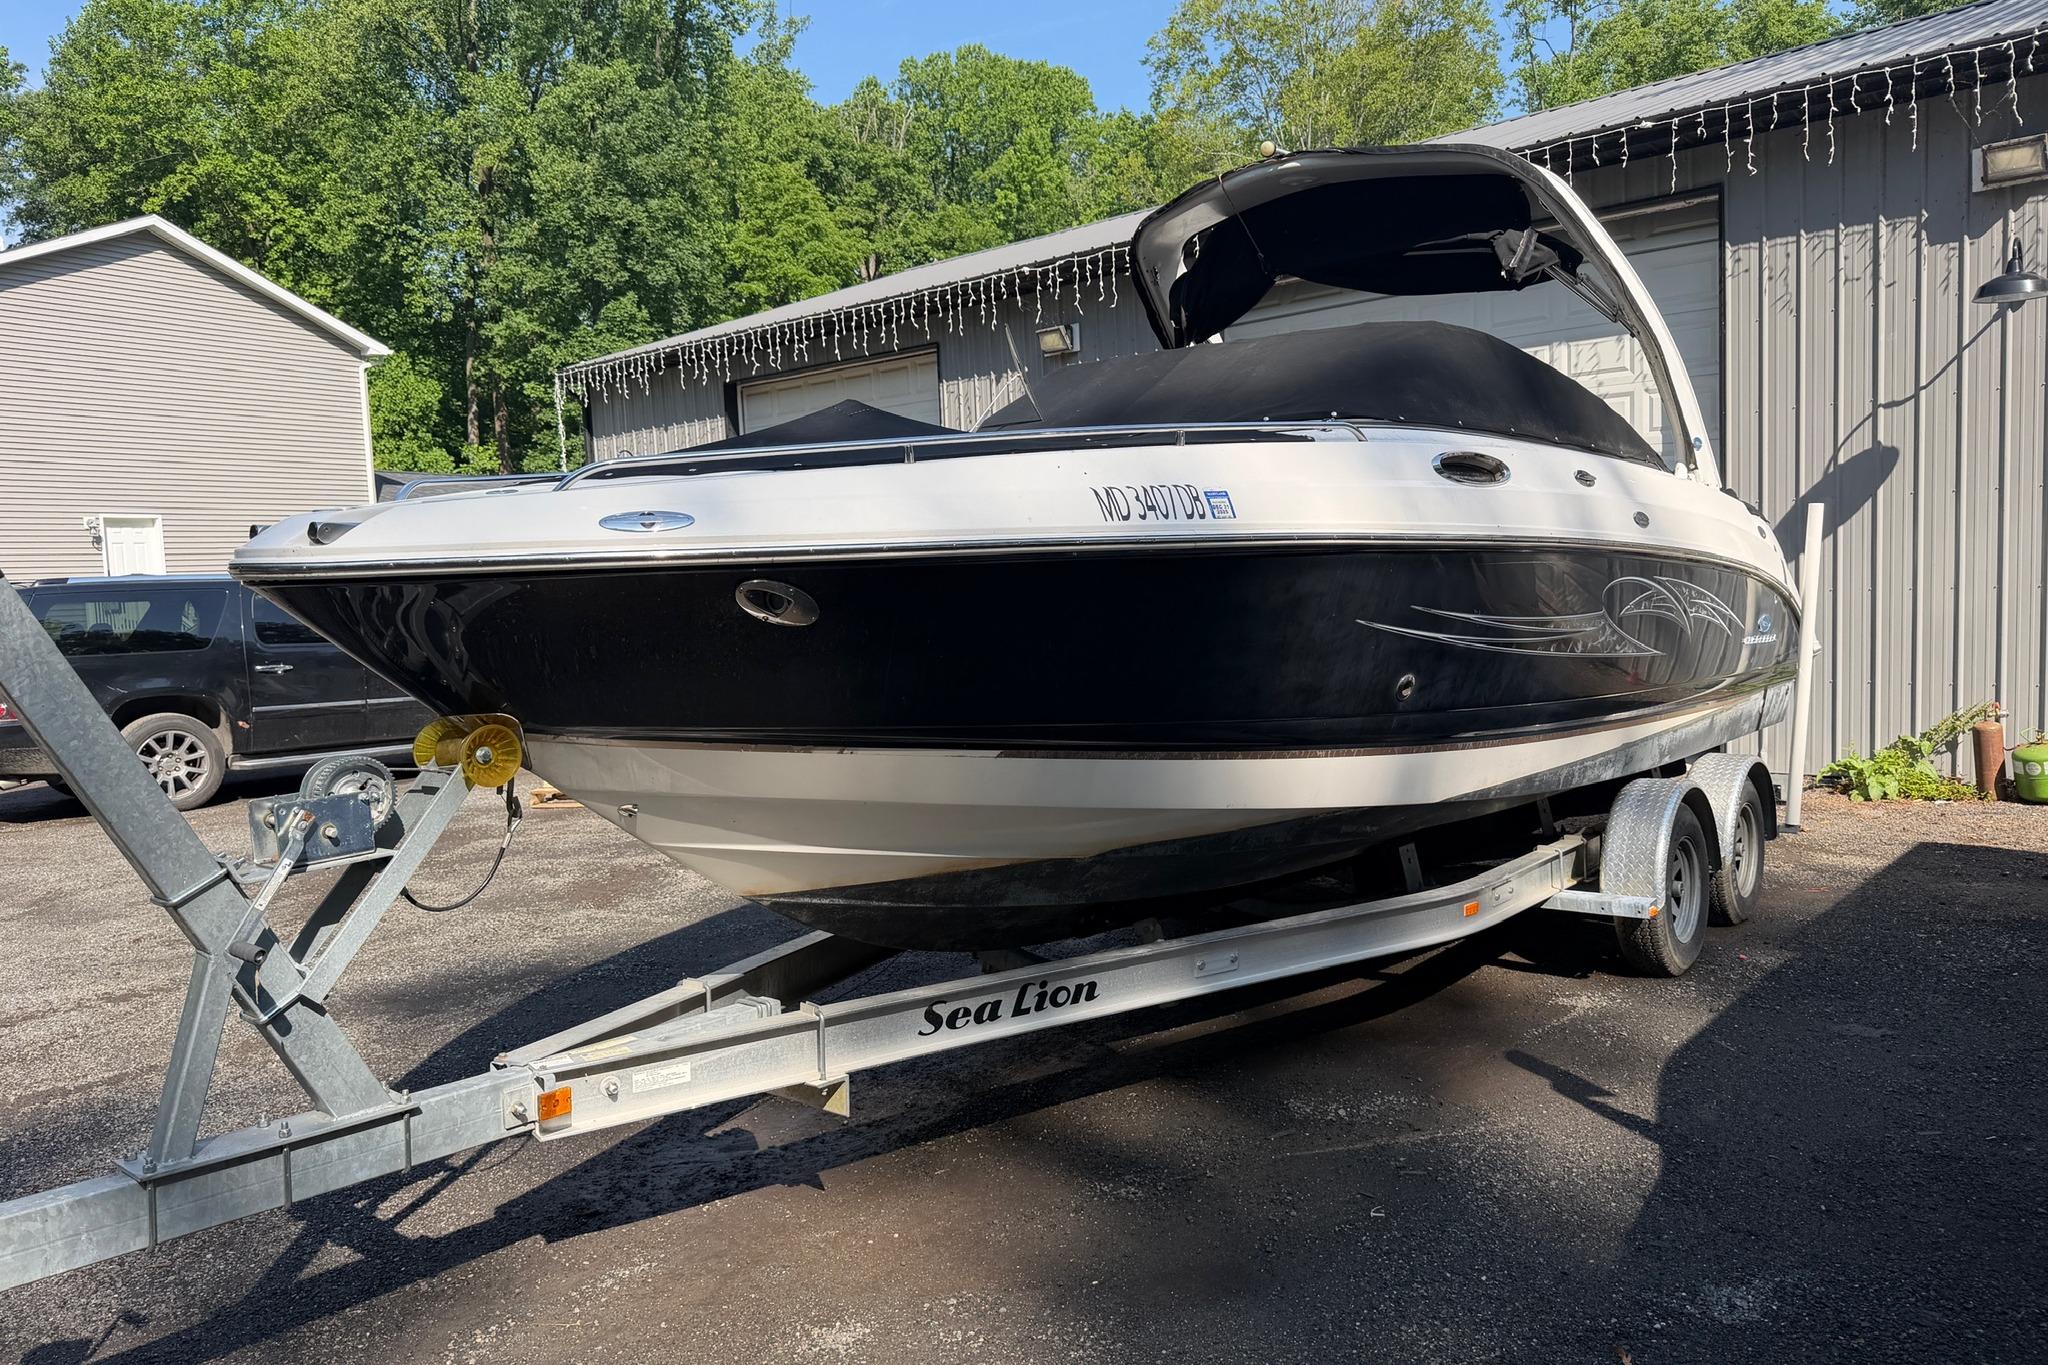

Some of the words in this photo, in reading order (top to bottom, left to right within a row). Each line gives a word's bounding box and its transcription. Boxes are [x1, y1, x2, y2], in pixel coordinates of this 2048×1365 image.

[1089, 487, 1131, 522] MD
[1126, 485, 1178, 521] 3407
[1172, 484, 1206, 520] DB
[917, 1000, 1003, 1036] Sea
[1010, 979, 1100, 1018] Lion
